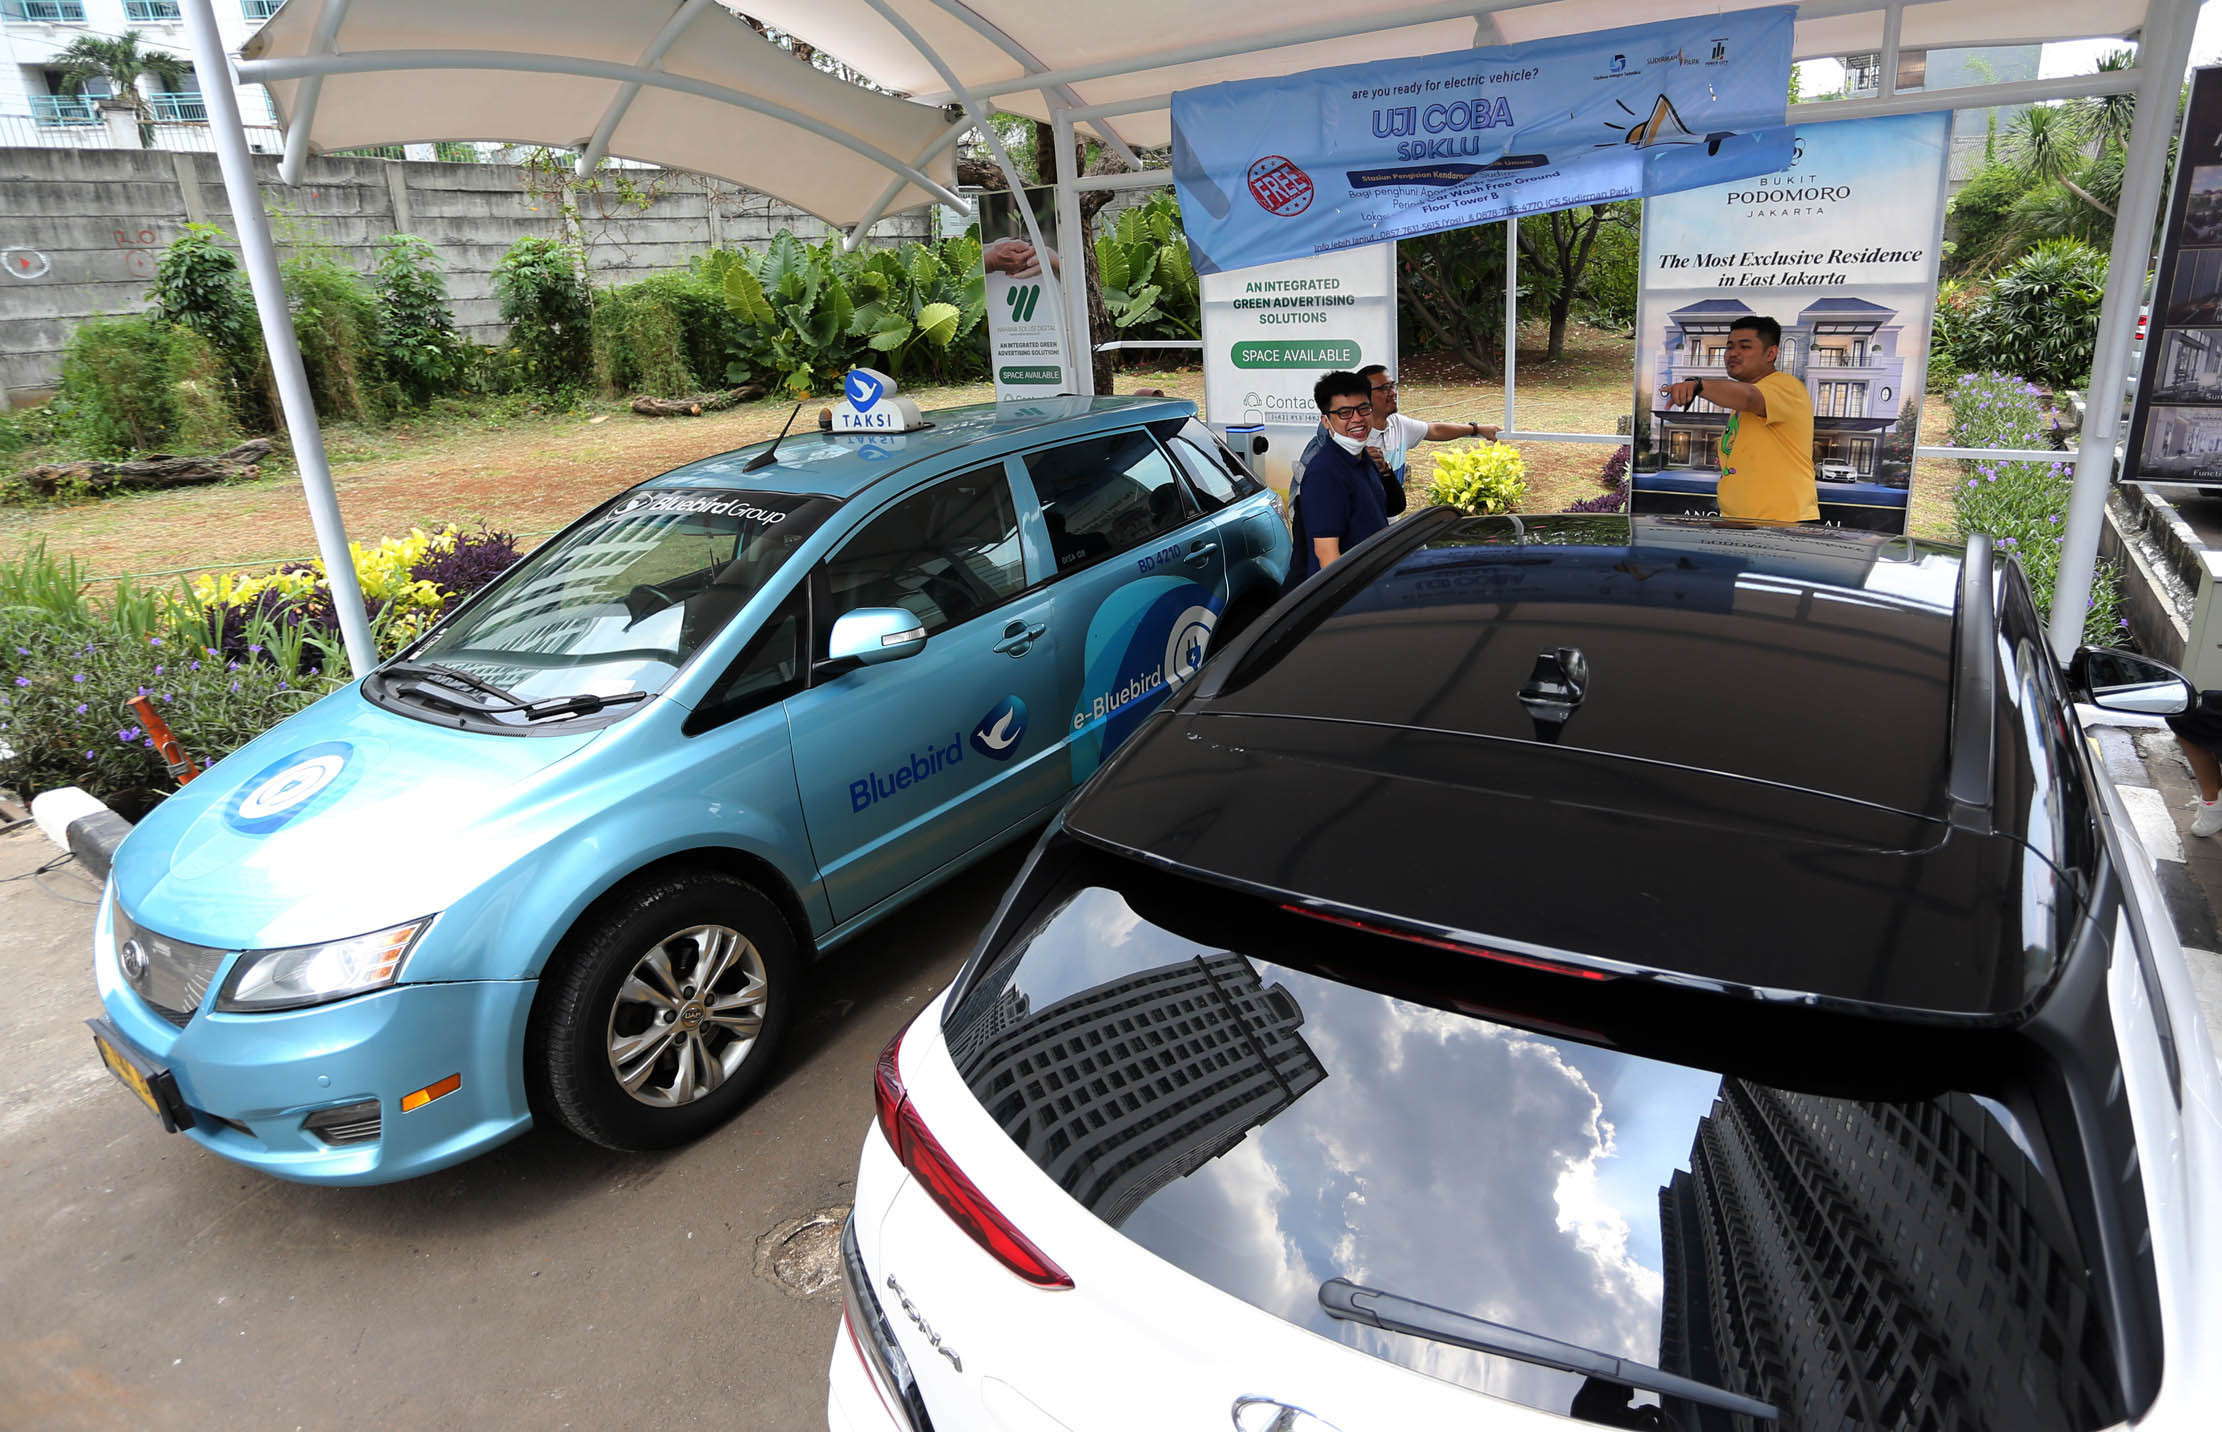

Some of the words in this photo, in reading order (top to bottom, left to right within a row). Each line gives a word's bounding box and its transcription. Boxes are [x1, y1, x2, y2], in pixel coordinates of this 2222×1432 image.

[1352, 89, 1369, 100] are
[1371, 86, 1390, 100] you
[1394, 81, 1423, 96] ready
[1425, 79, 1441, 92] for
[1445, 74, 1485, 90] electric
[1490, 67, 1539, 85] vehicle?
[1372, 106, 1417, 138] UJI
[1423, 97, 1514, 134] COBA
[1397, 136, 1480, 161] SPKLU
[1361, 174, 1392, 182] Stasiun
[1393, 172, 1432, 181] Pengisian
[1451, 186, 1483, 198] Wash
[1514, 171, 1561, 185] Ground
[1760, 175, 1817, 186] BUKIT
[1254, 166, 1308, 208] FREE
[1348, 190, 1373, 200] Bagi
[1375, 187, 1418, 200] penghuni
[1727, 186, 1851, 205] PODOMORO
[1422, 203, 1450, 213] Floor
[1452, 195, 1488, 207] Tower
[1491, 192, 1499, 200] B
[1314, 244, 1330, 253] Info
[1331, 238, 1351, 249] lebih
[1352, 233, 1374, 247] lanjut
[1563, 189, 1609, 206] Sudirman
[1609, 186, 1633, 198] Park)
[1747, 207, 1825, 218] JAKARTA
[1659, 253, 1690, 269] The
[1692, 251, 1737, 268] Most
[1739, 249, 1824, 267] Exclusive
[1826, 247, 1923, 265] Residence
[1246, 282, 1262, 293] AN
[1264, 279, 1340, 291] INTEGRATED
[1718, 273, 1735, 287] in
[1738, 272, 1777, 287] East
[1777, 270, 1847, 287] Jakarta
[1233, 297, 1271, 309] GREEN
[1273, 295, 1355, 308] ADVERTISING
[1259, 312, 1327, 324] SOLUTIONS
[1242, 350, 1280, 362] SPACE
[1283, 349, 1351, 362] AVAILABLE
[1003, 371, 1024, 379] SPACE
[1025, 371, 1060, 379] AVAILABLE
[1265, 394, 1317, 409] Contac
[842, 413, 892, 428] TAKSI
[1138, 557, 1156, 574] BD
[1156, 544, 1182, 567] 4210
[1073, 665, 1162, 730] e-Bluebird
[849, 732, 963, 813] Bluebird
